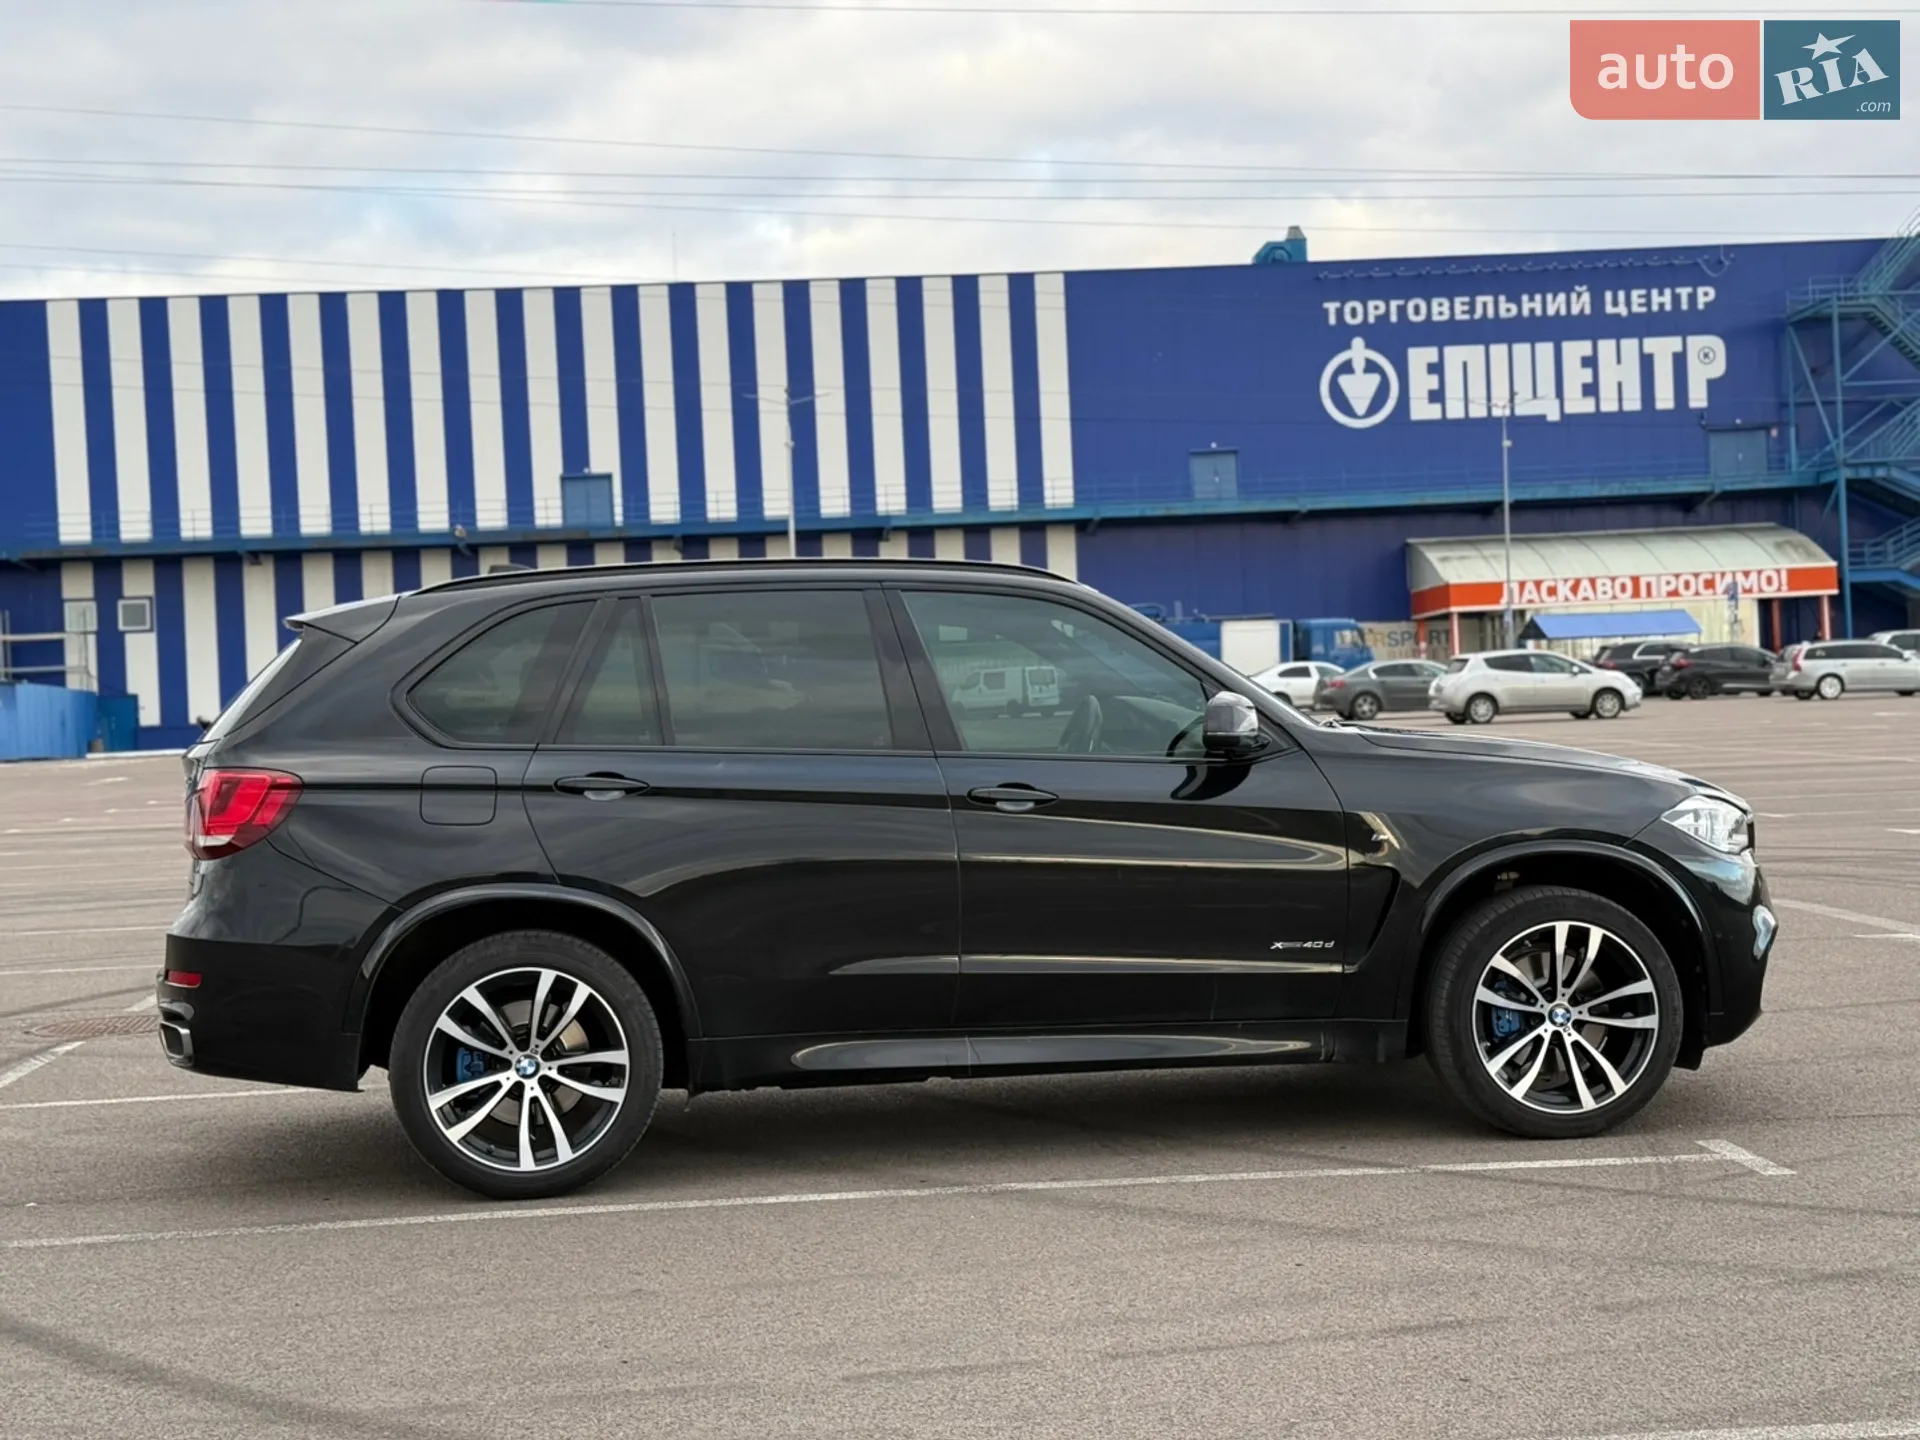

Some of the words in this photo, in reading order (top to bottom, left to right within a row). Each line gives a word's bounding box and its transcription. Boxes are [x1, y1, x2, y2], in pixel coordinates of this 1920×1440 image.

[1323, 285, 1591, 326] ТОРГОВЕЛЬНИЙ
[1605, 286, 1716, 317] ЦЕНТР
[1407, 334, 1727, 422] ЕПІЦЕНТР
[1499, 576, 1634, 605] ЛАСКАВО
[1640, 568, 1789, 599] ПРОСИМО!
